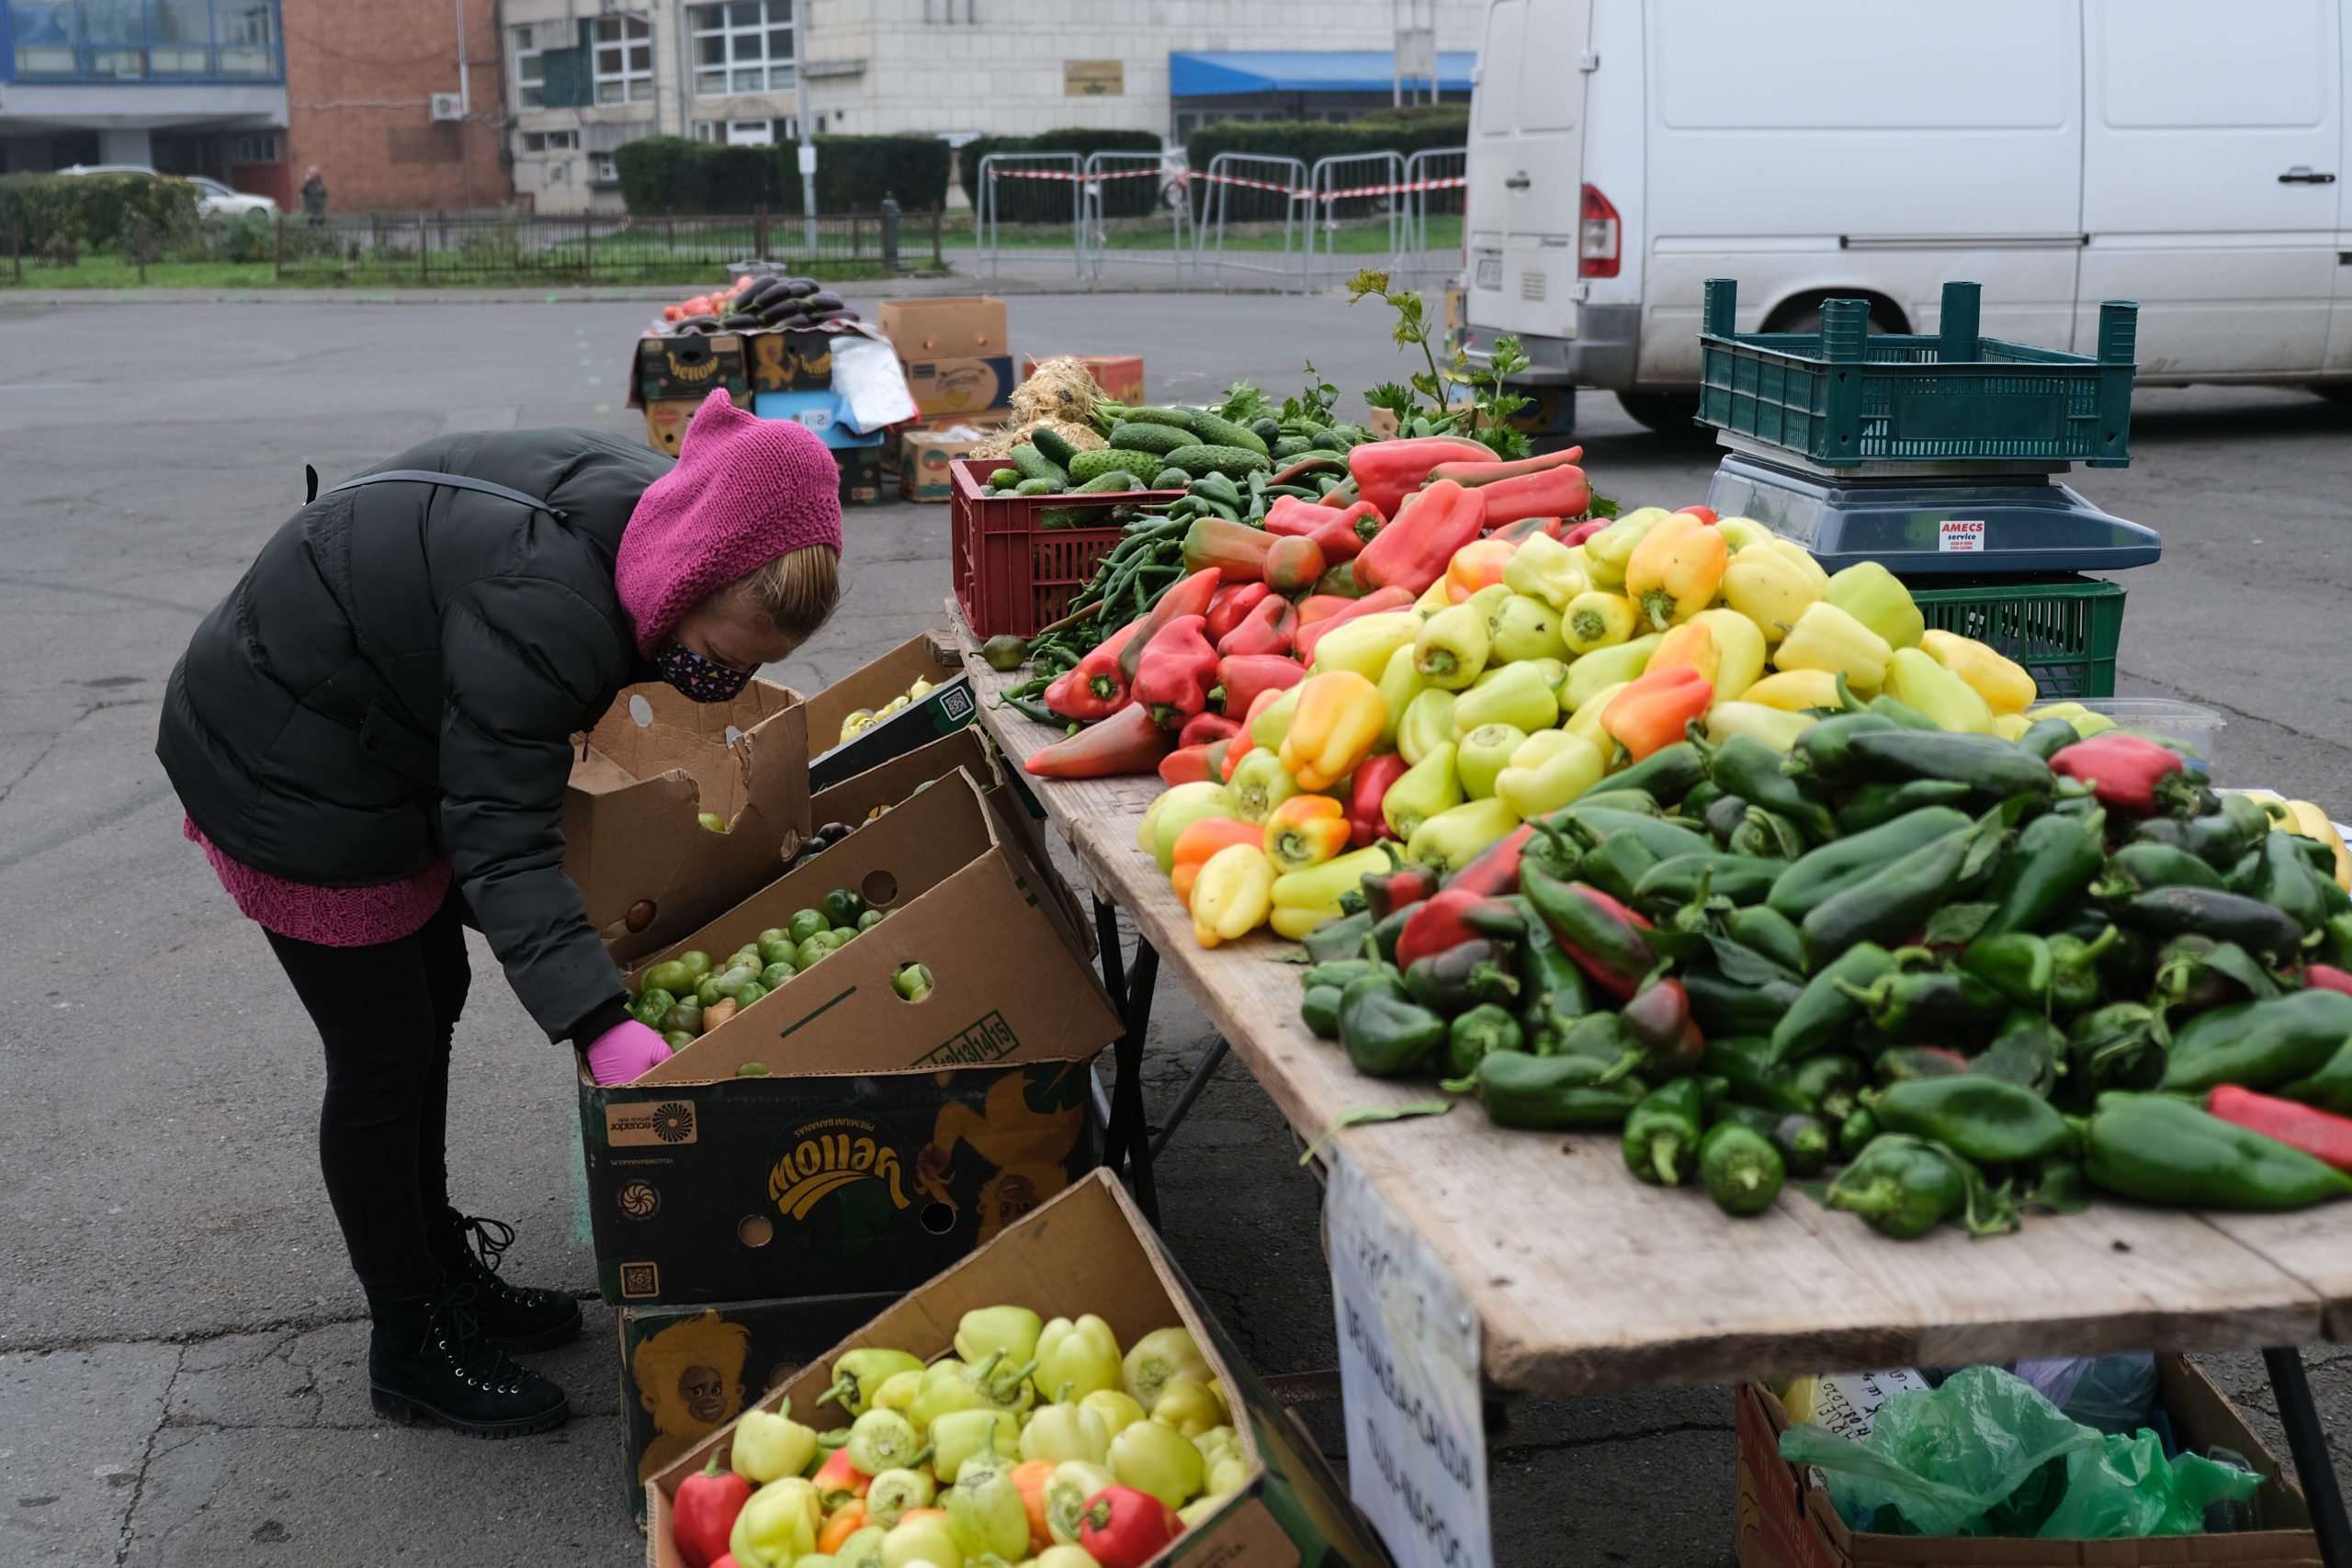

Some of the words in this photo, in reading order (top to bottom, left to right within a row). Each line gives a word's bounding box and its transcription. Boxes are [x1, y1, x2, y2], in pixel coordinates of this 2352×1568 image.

[666, 352, 720, 381] yellow
[1941, 523, 1984, 533] AMECS
[956, 1043, 974, 1063] 13
[974, 1032, 994, 1056] 14
[989, 1021, 1011, 1045] 15
[610, 1122, 651, 1132] ecuador
[794, 1118, 833, 1138] BANANAS
[834, 1118, 875, 1132] PREMIUM
[768, 1134, 911, 1210] yellow
